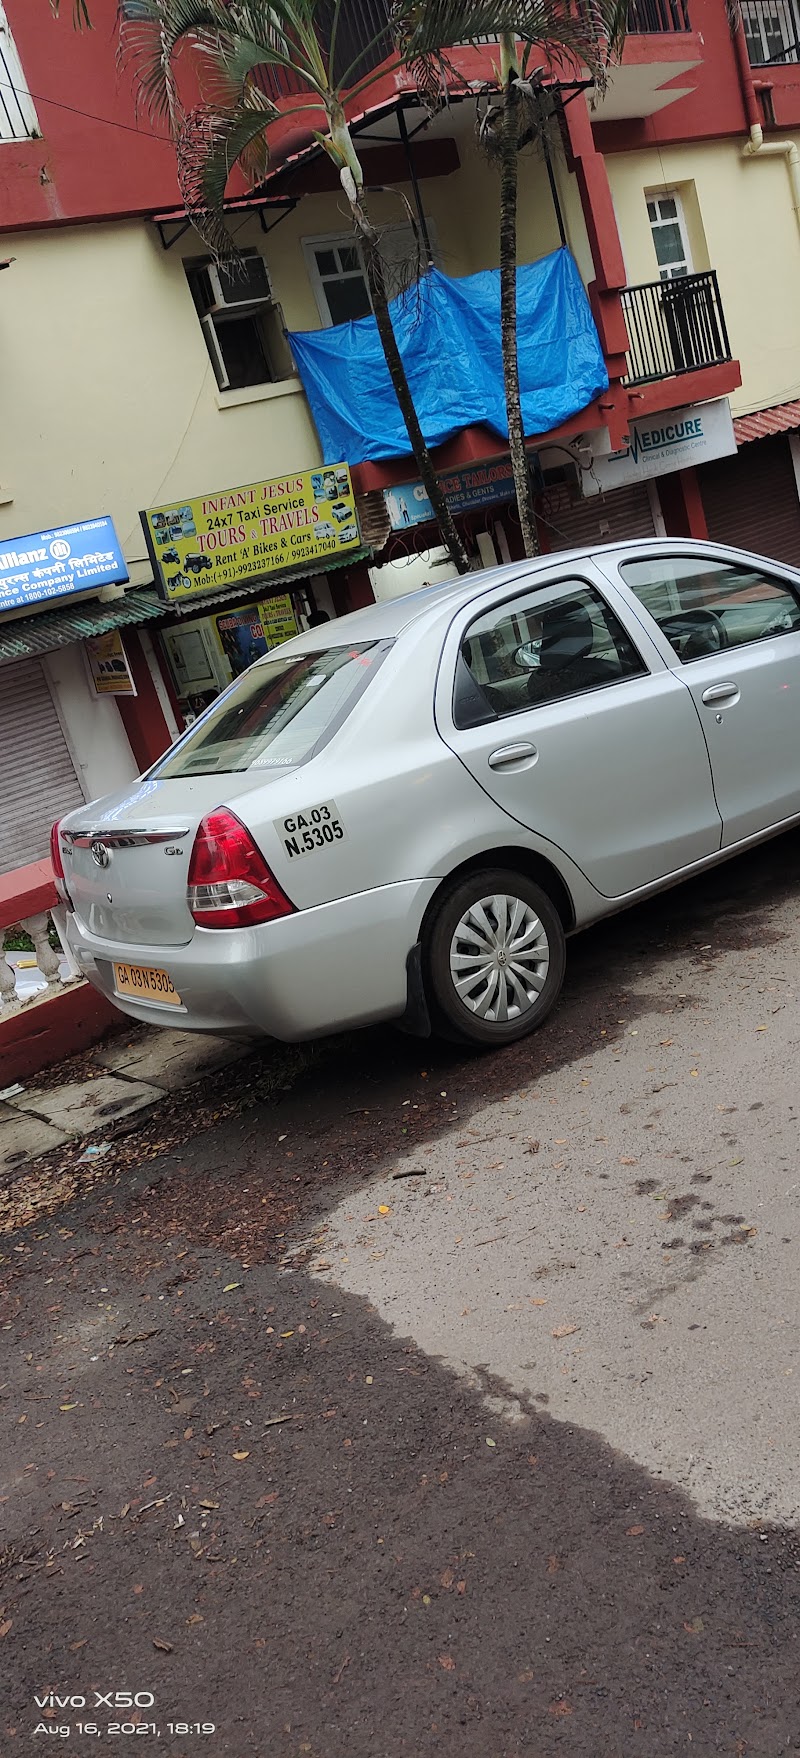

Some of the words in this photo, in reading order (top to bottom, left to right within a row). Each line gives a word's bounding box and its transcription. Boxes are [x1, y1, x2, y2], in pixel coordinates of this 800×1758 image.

[462, 464, 513, 489] TAILORS
[202, 490, 256, 515] INFANT
[261, 478, 303, 501] JESUS
[445, 493, 465, 504] ADIES
[466, 491, 471, 499] &
[472, 486, 495, 498] GENTS
[206, 511, 234, 531] 24x7
[238, 507, 261, 523] Taxi
[263, 498, 305, 516] Service
[196, 524, 246, 553] TOURS
[251, 529, 258, 540] &
[259, 505, 319, 536] TRAVELS
[215, 550, 237, 566] Rent
[253, 541, 278, 557] Bikes
[281, 538, 288, 549] &
[290, 532, 312, 546] Cars
[291, 540, 336, 560] 9923417040
[22, 573, 75, 592] Company
[77, 560, 119, 578] Limited
[32, 562, 66, 579] कंपनी
[68, 551, 114, 571] लिमिटेड
[16, 596, 24, 604] at
[24, 583, 75, 601] 1800-102-5858
[283, 805, 332, 833] GA.03
[284, 820, 344, 858] N.5305
[118, 966, 130, 985] GA
